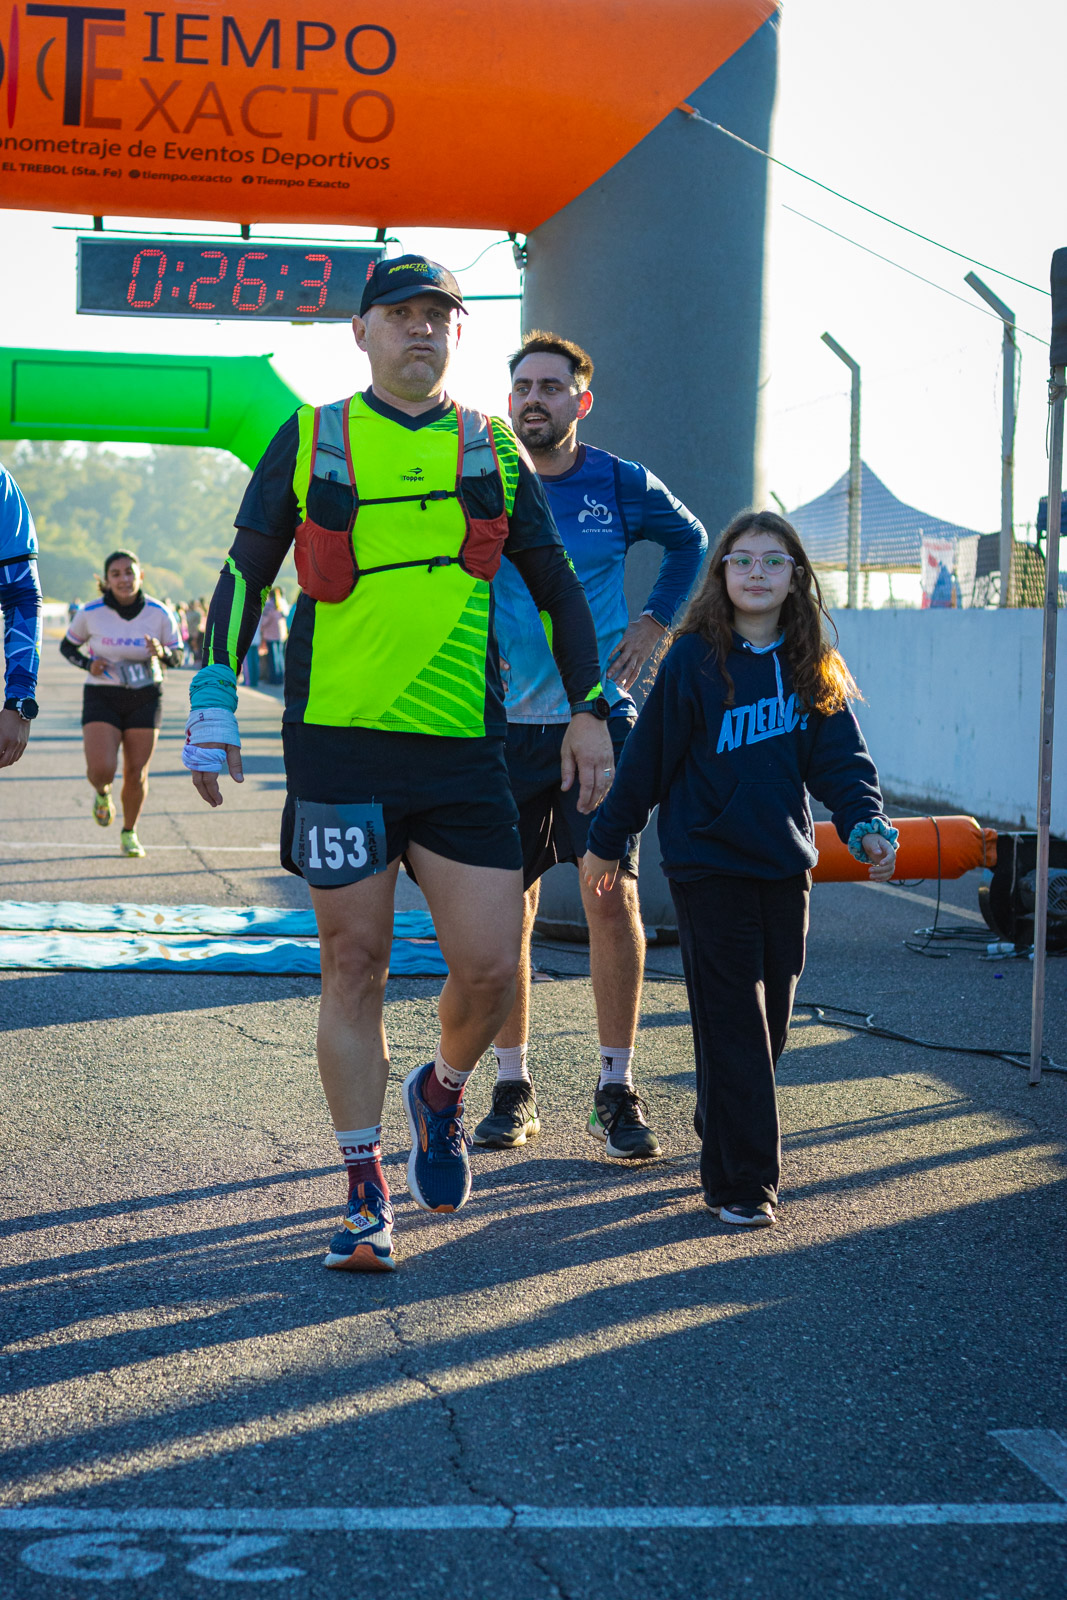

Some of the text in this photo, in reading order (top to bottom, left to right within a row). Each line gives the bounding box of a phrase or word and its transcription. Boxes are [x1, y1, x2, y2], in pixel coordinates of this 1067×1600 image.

[0, 136, 391, 170] nometraje de Eventos Deportivos
[2, 162, 17, 172] EL
[20, 163, 69, 175] TREBOL
[72, 166, 100, 177] (Sta.
[103, 168, 122, 178] Fe)
[256, 176, 304, 188] Tiempo
[308, 179, 350, 189] Exacto
[127, 249, 375, 313] 0:26:3
[101, 637, 145, 647] RUNNE
[309, 826, 368, 870] 153
